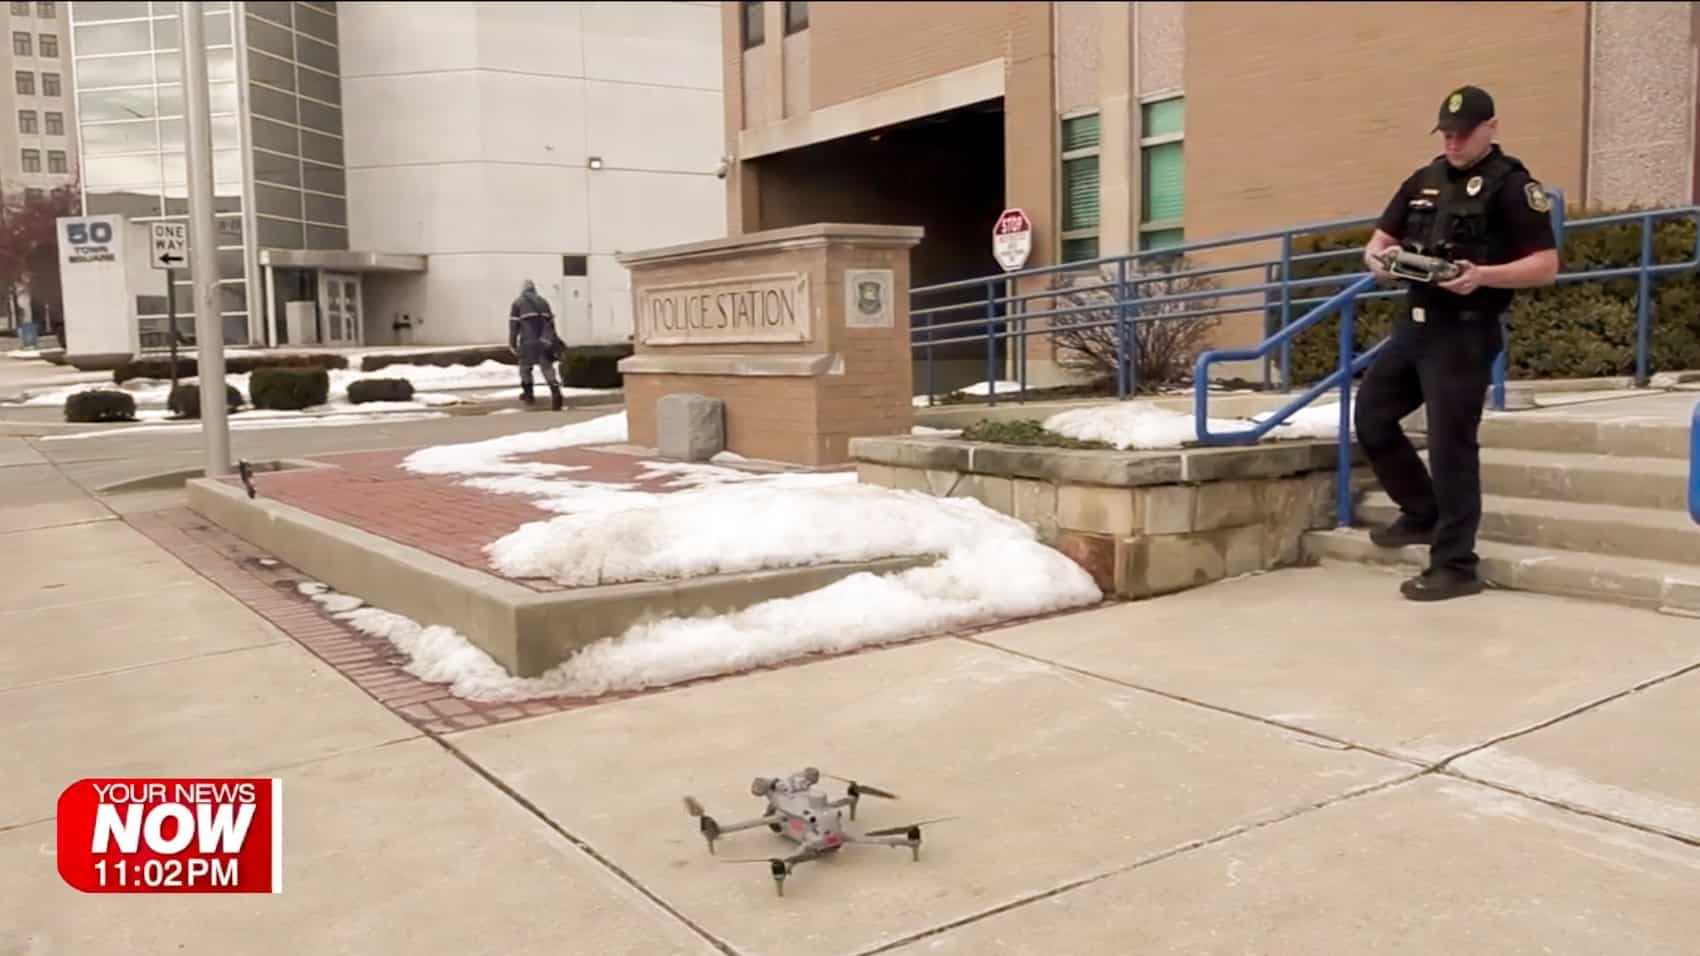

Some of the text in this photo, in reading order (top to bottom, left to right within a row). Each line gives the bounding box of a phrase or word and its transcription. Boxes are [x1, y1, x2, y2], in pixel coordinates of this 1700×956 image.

[67, 222, 112, 244] 50
[155, 225, 185, 238] ONE
[156, 240, 185, 251] WAY
[653, 288, 796, 331] POLICE STATION
